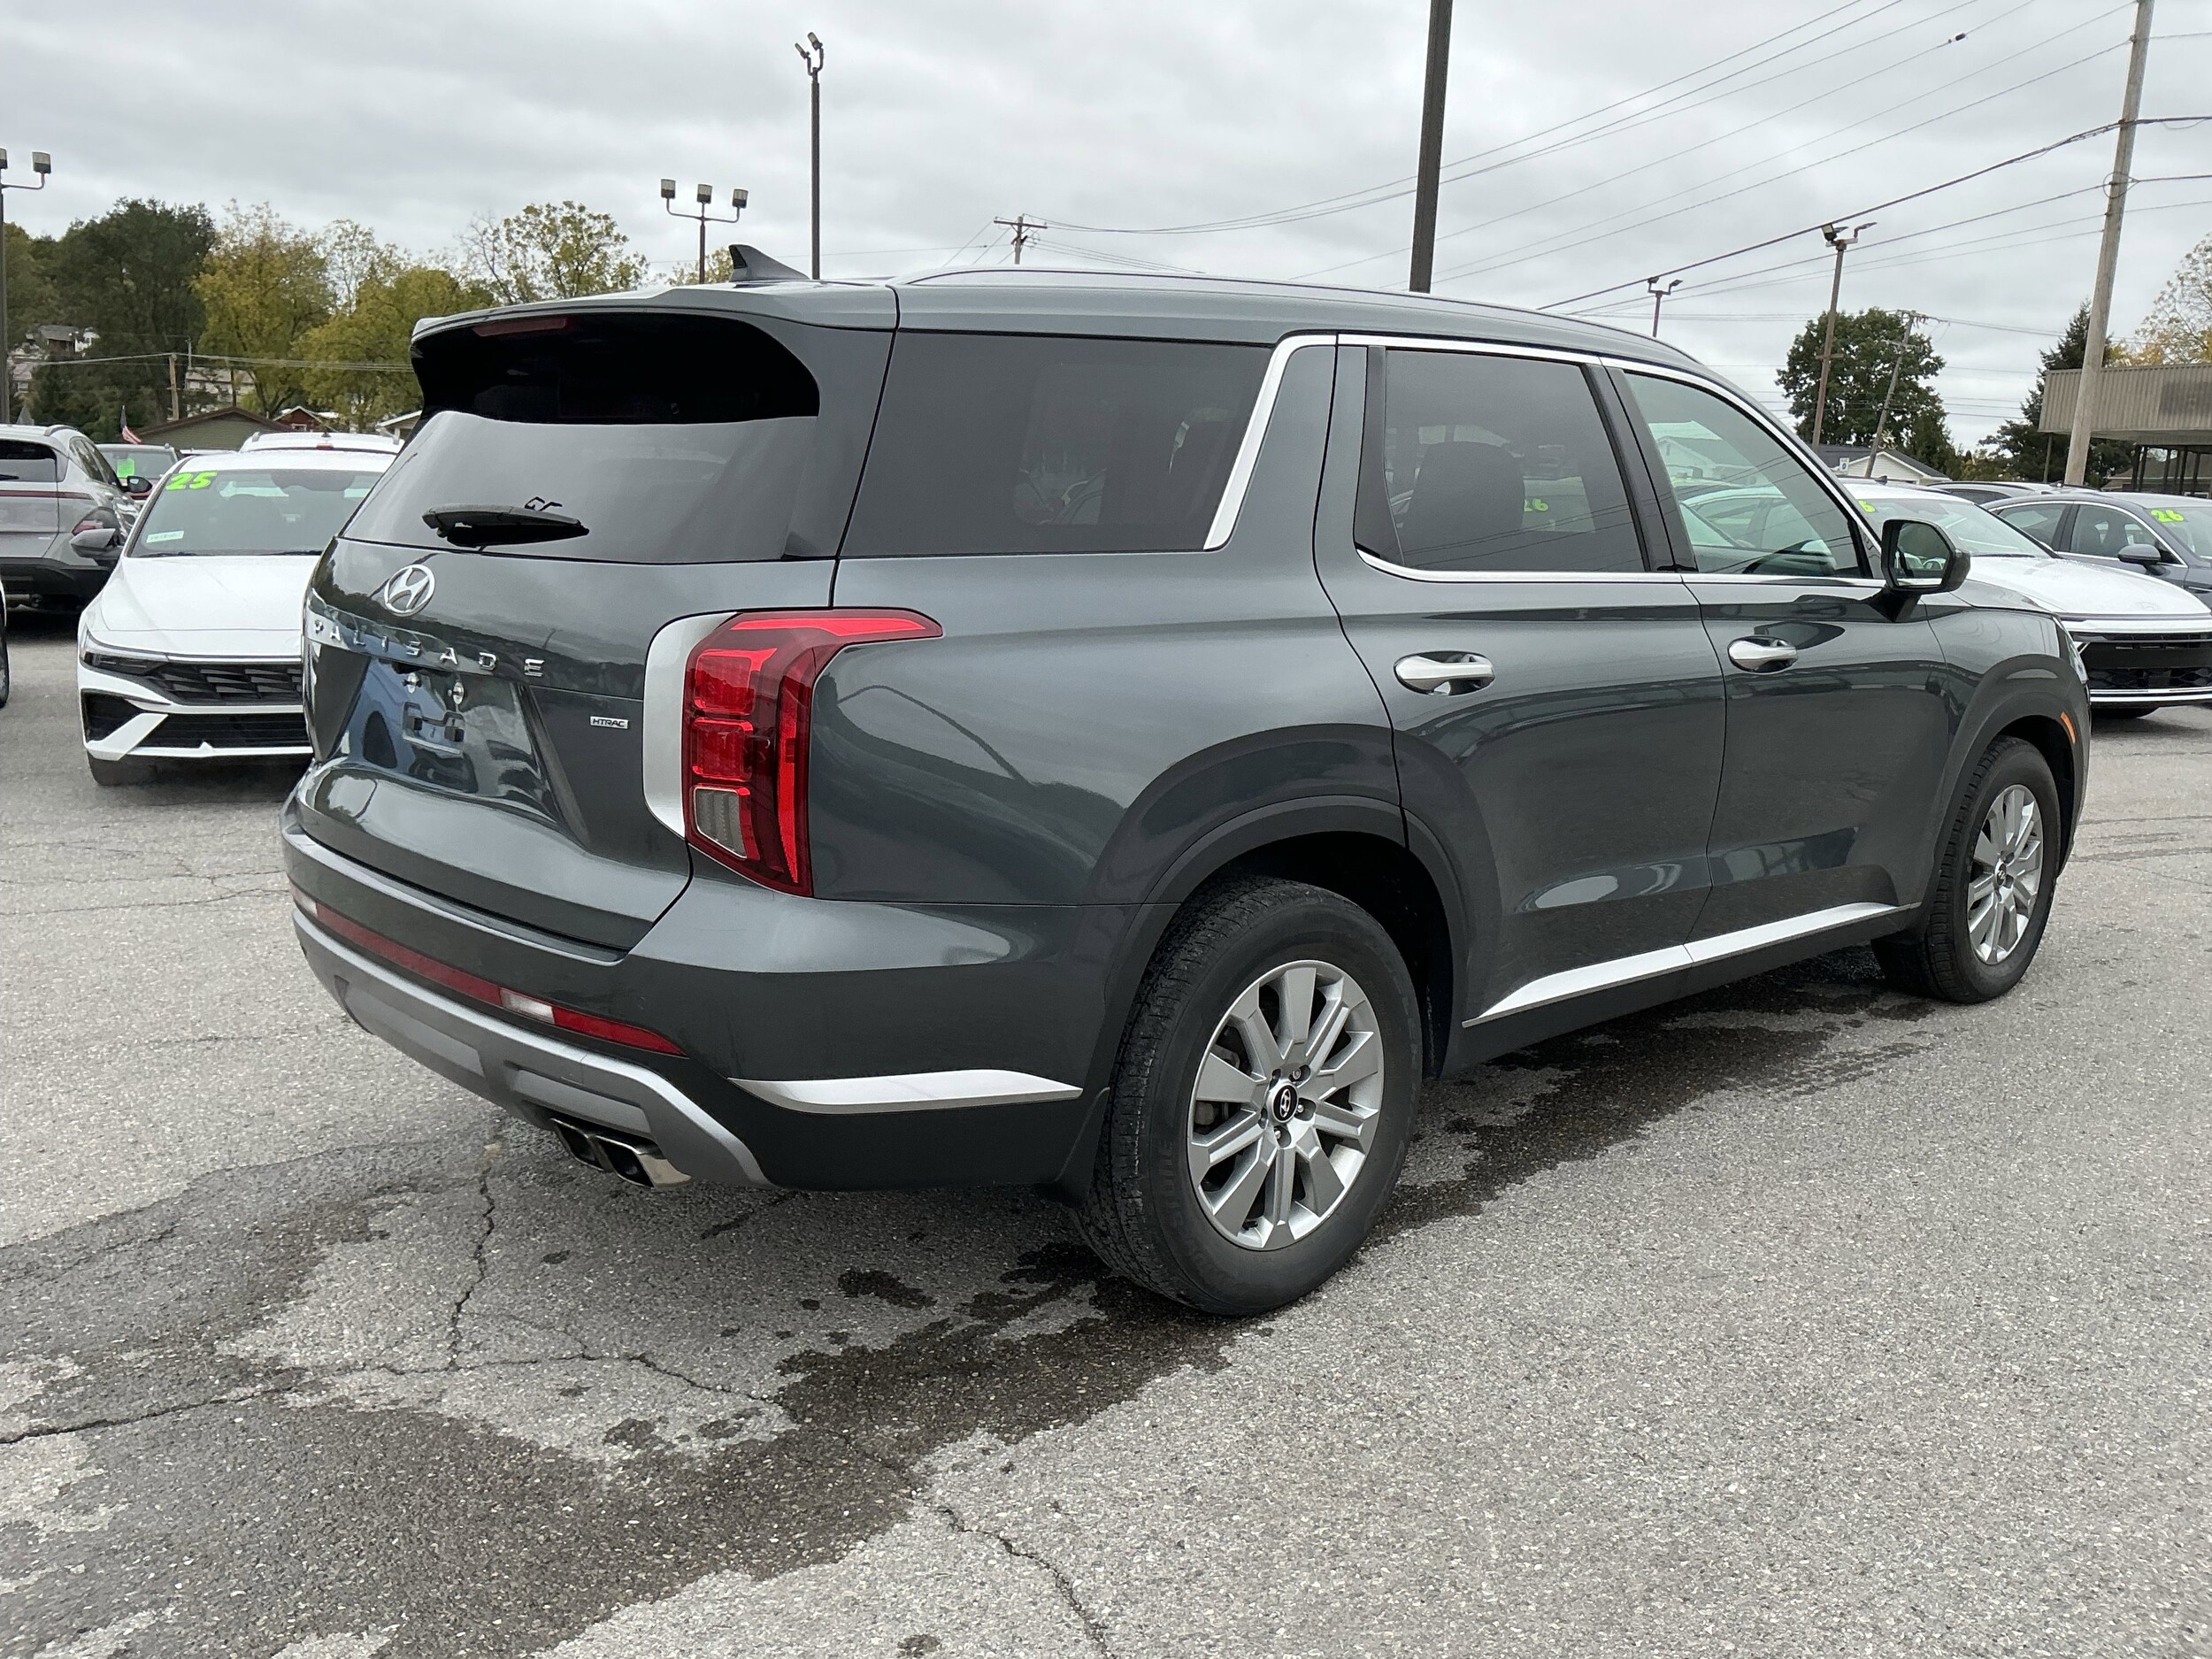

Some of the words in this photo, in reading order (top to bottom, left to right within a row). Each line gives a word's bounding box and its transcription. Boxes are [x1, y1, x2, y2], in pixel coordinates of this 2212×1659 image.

[165, 471, 218, 490] 25
[2150, 509, 2185, 524] 26
[313, 618, 545, 678] PALISADE
[591, 717, 626, 728] HTRAC
